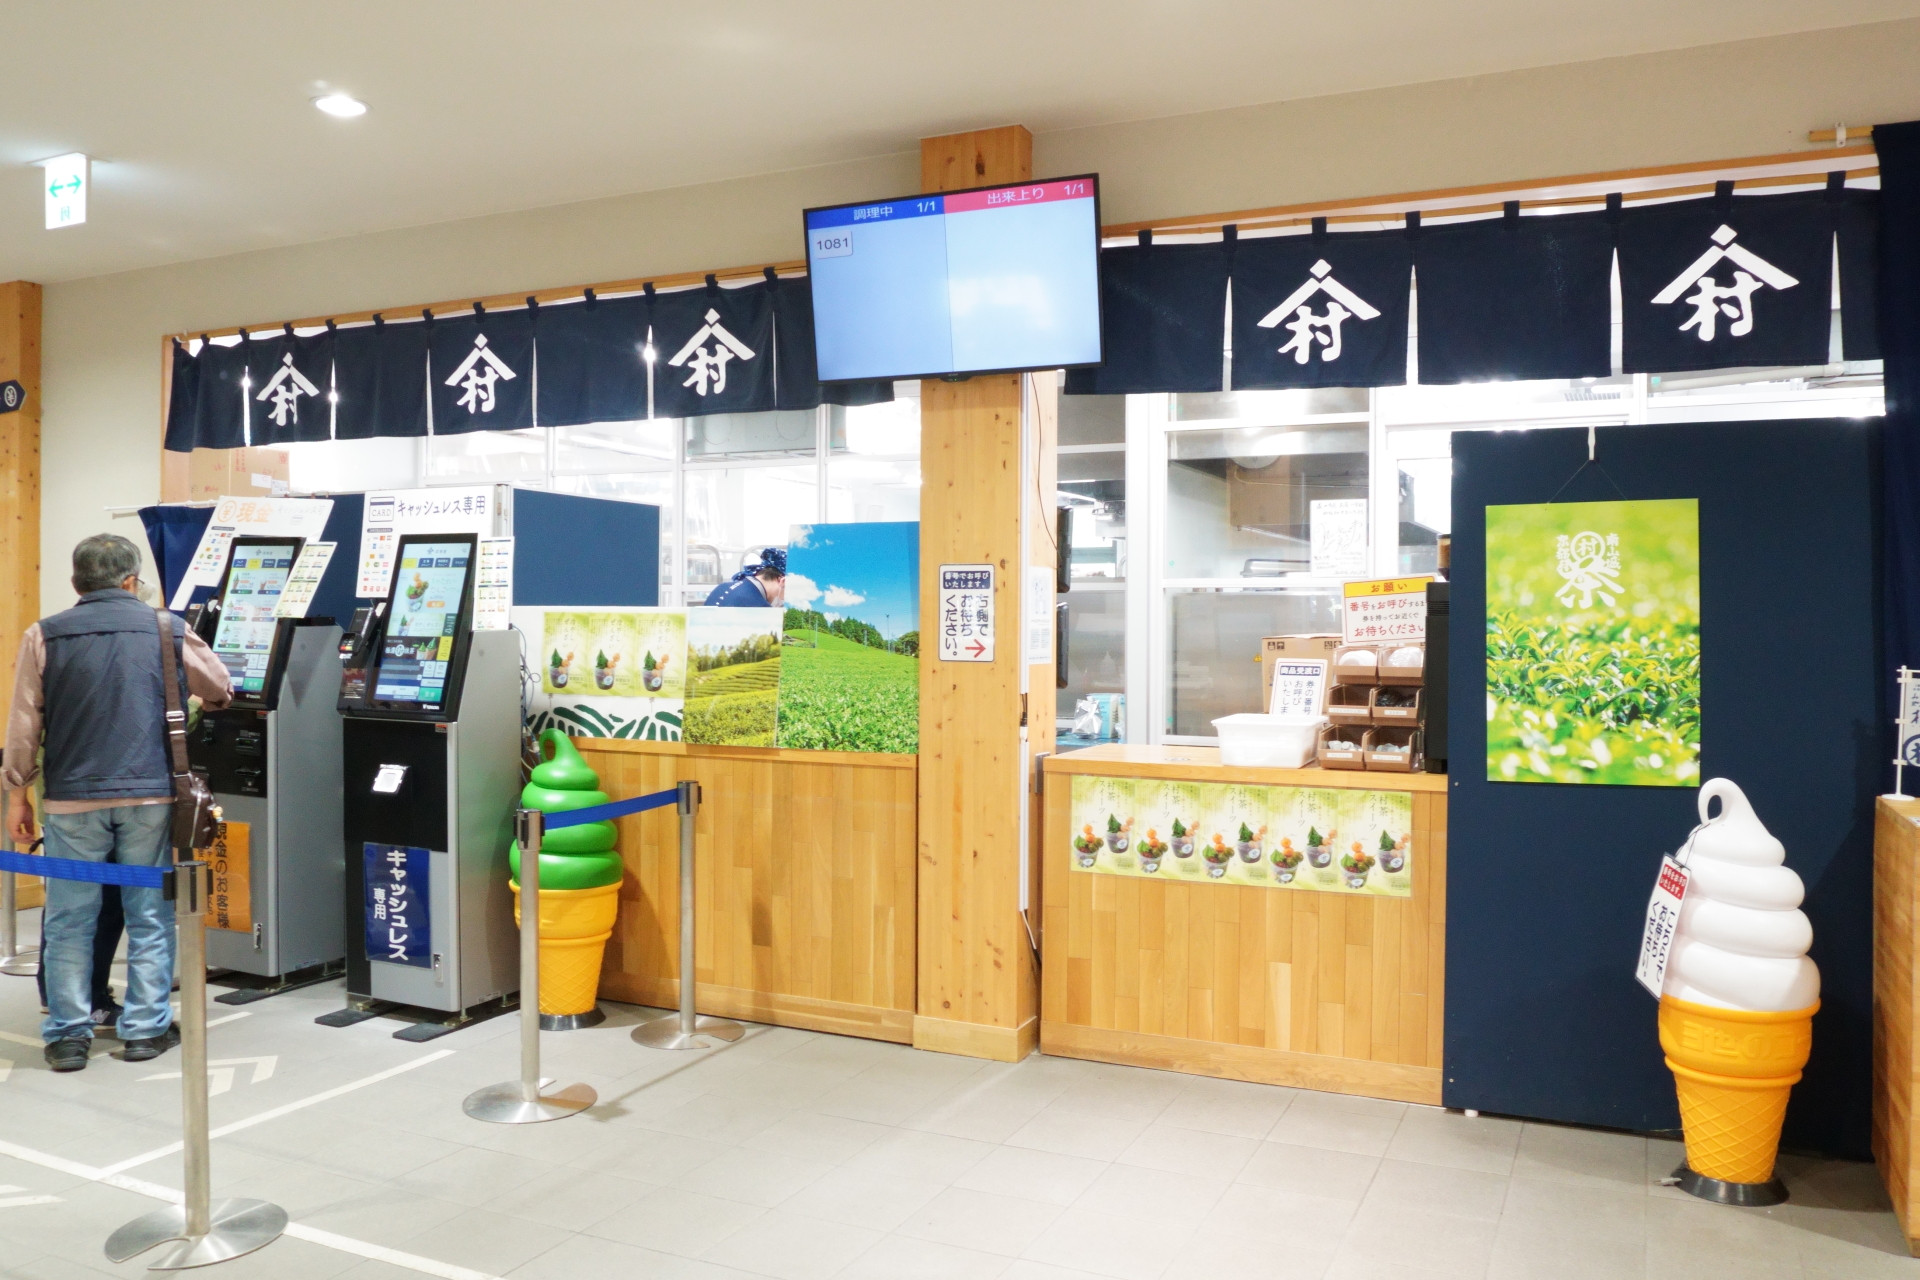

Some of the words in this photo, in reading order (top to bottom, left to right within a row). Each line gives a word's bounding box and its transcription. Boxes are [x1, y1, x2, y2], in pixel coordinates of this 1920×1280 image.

[987, 187, 1044, 205] 出来上り
[1064, 183, 1085, 196] 1/1
[853, 207, 893, 221] 調理中
[916, 201, 936, 213] 1/1
[816, 237, 850, 251] 1081
[236, 502, 275, 523] 現金
[371, 509, 392, 517] CARD
[397, 496, 486, 516] キャッシュレス専用
[1604, 533, 1621, 569] 南山城
[945, 572, 989, 580] 番号でお呼び
[1371, 582, 1408, 593] お願い
[945, 594, 958, 656] ください。
[960, 594, 974, 637] お待ち
[976, 594, 989, 636] 右側で
[1293, 680, 1304, 706] お呼び
[1107, 780, 1116, 801] 村茶
[1162, 783, 1170, 818] スイーツ
[1171, 784, 1180, 806] 村茶
[1238, 788, 1247, 809] 村茶
[1229, 787, 1237, 823] スイーツ
[1298, 791, 1306, 827] スイーツ
[1307, 792, 1316, 813] 村茶
[1369, 794, 1377, 831] スイーツ
[1379, 795, 1388, 817] 村茶
[373, 887, 387, 920] 専用
[387, 850, 409, 961] キャッシュレス
[1641, 901, 1660, 978] ください。
